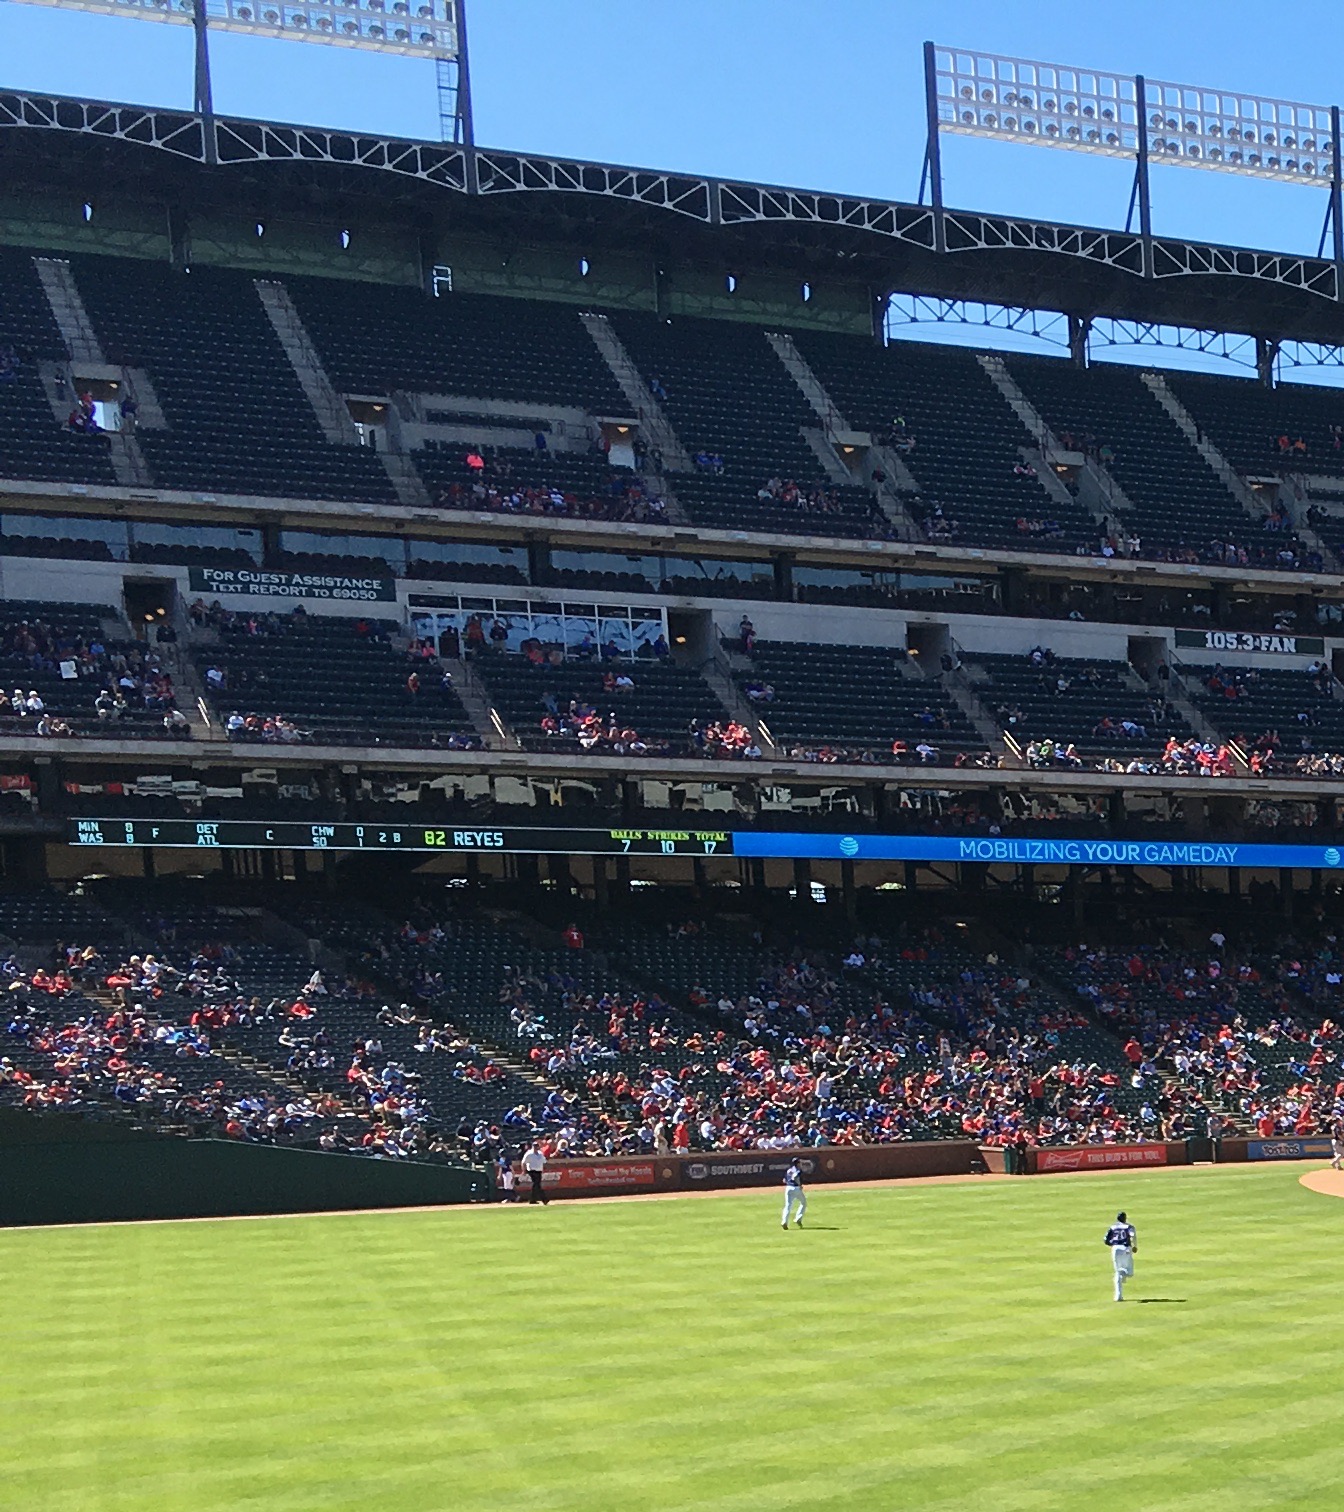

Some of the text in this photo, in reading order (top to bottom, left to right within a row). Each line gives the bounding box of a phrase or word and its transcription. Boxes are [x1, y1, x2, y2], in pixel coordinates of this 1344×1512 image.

[203, 568, 382, 590] FOR GUEST ASSISTANCE
[210, 581, 243, 593] TEXT
[250, 583, 308, 597] REPORT
[333, 589, 377, 600] 69050
[1205, 631, 1254, 651] 105.3
[1260, 635, 1297, 654] FAN
[78, 821, 99, 832] MIN
[196, 823, 219, 835] DET
[311, 825, 334, 837] CHW
[78, 833, 104, 844] WAS
[152, 828, 160, 839] F
[453, 831, 504, 847] REYES
[610, 829, 728, 841] BALLS STRIKES TOTAL
[197, 835, 219, 846] ATL
[621, 840, 717, 854] 7 10 17
[959, 840, 1238, 863] MOBILIZING YOUR GAMEDAY
[711, 1163, 764, 1176] SOUTHWEST
